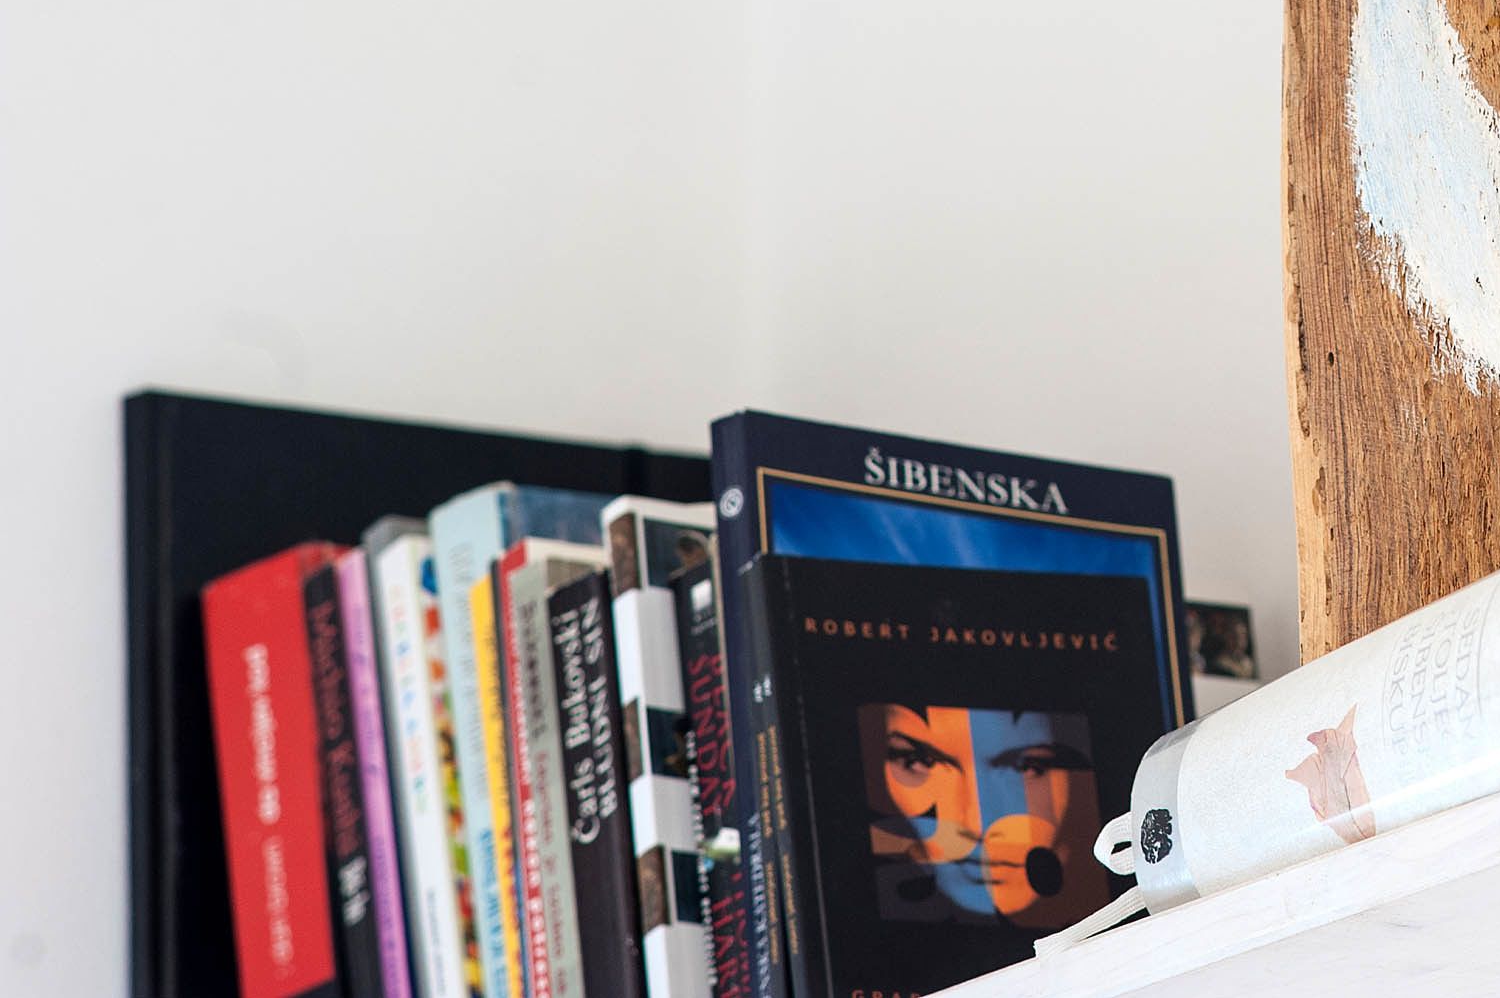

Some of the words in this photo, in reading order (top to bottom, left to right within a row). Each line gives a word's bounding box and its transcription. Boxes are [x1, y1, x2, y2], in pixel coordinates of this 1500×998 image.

[863, 446, 1069, 515] ŠIBENSKA
[581, 596, 604, 666] SIN
[804, 616, 910, 640] ROBERT
[929, 625, 1118, 651] JAKOVLJEVIĆ
[552, 608, 591, 749] Bukovski
[588, 674, 618, 819] BLUDNI
[687, 654, 722, 815] SUNDAY
[570, 756, 600, 844] Čarls
